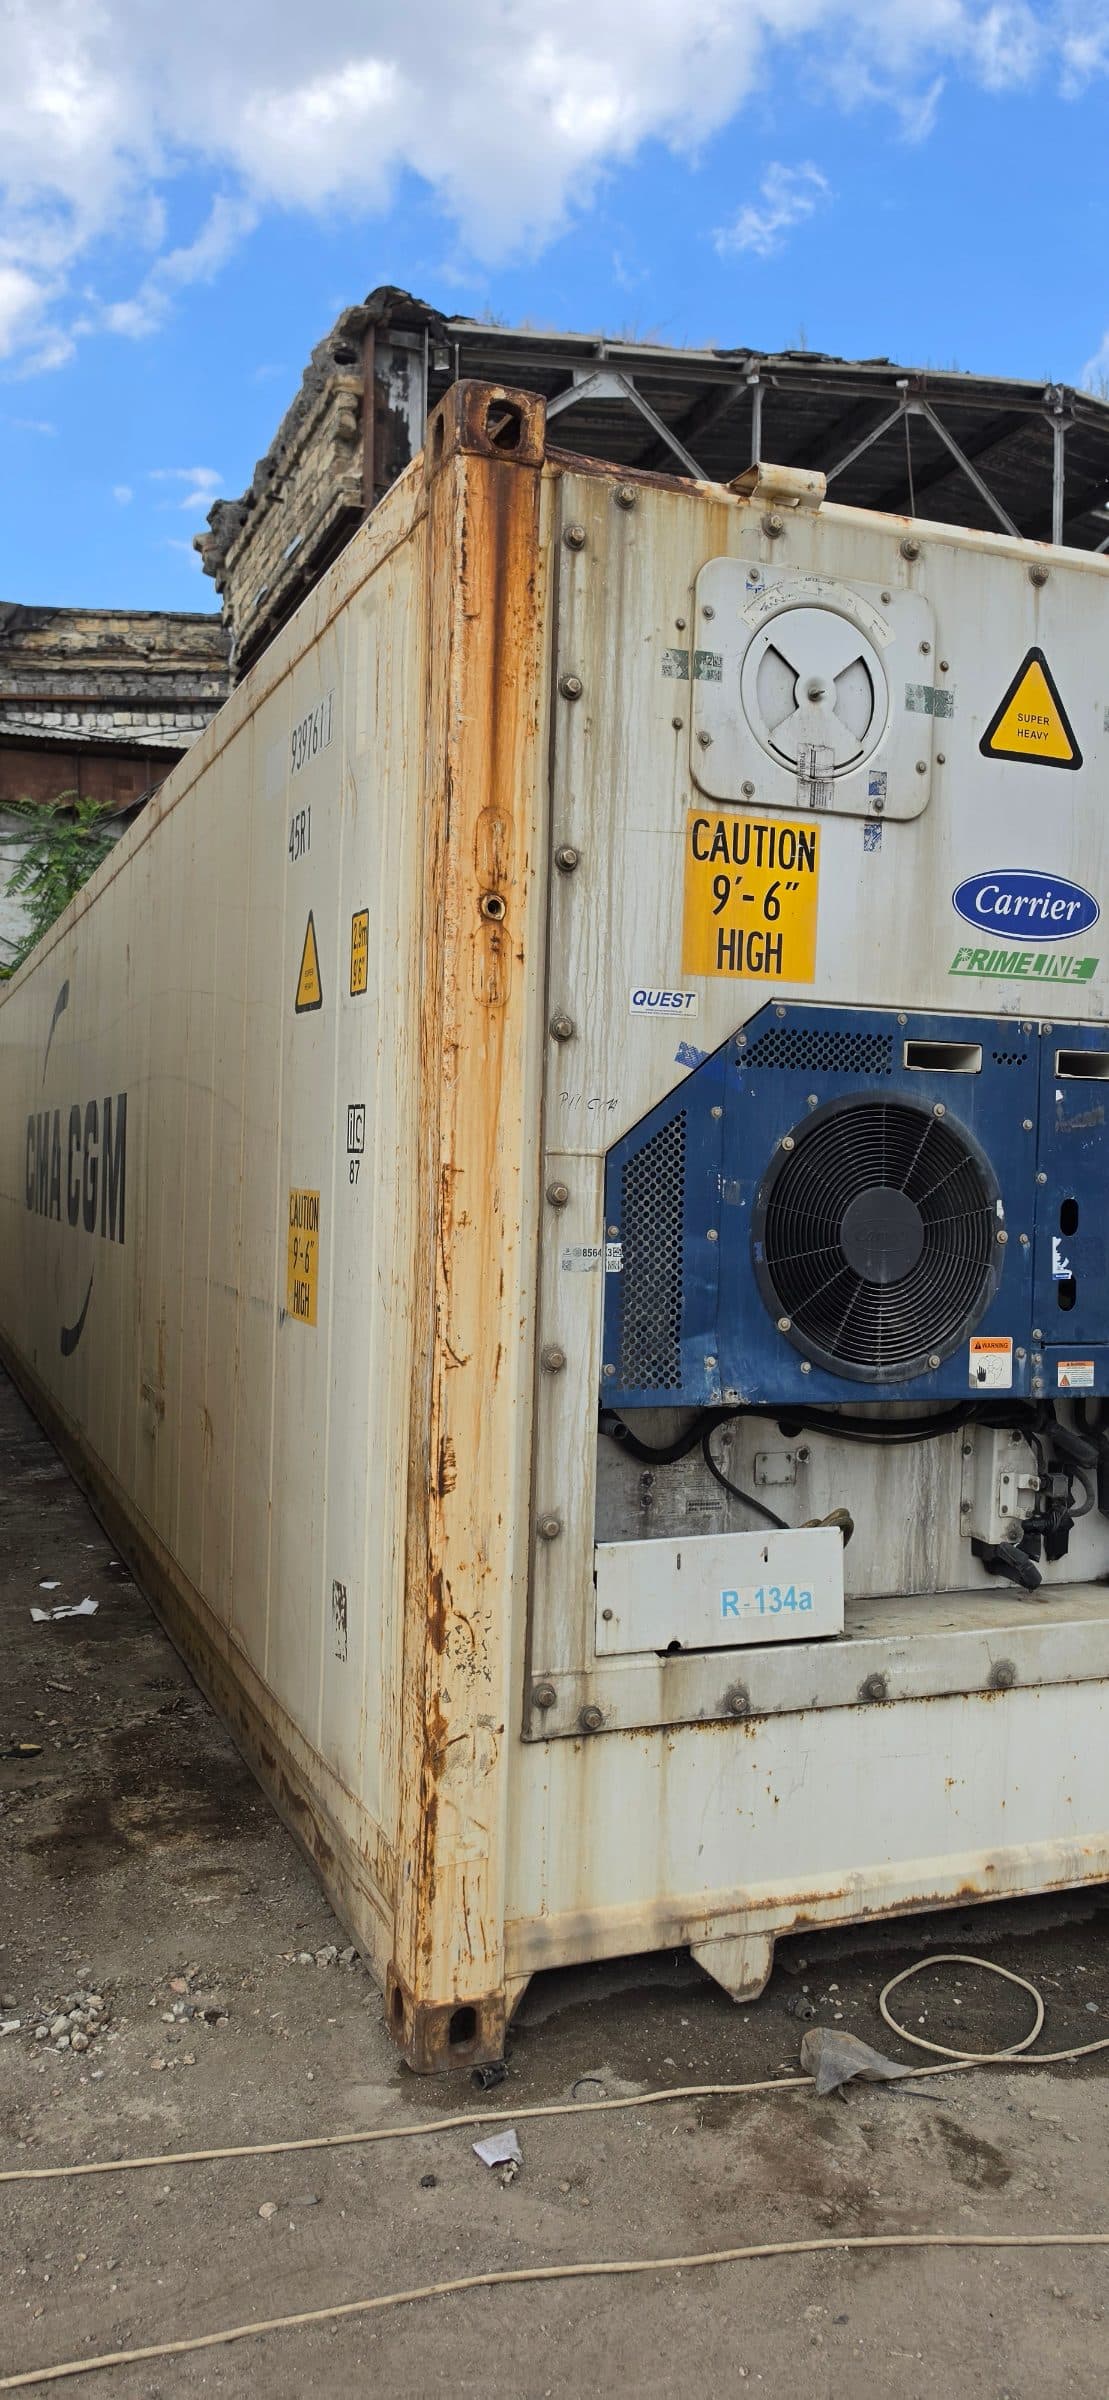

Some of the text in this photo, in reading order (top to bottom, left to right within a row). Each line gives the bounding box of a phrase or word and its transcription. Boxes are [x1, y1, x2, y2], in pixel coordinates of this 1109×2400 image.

[1016, 712, 1050, 727] SUPER
[1016, 727, 1050, 742] HEAVY
[288, 805, 311, 862] 45R1
[691, 818, 816, 873] CAUTION
[974, 885, 1081, 921] Carrier
[716, 927, 783, 975] HIGH
[632, 990, 696, 1009] QUEST
[25, 1092, 128, 1244] CMA CGM
[349, 1160, 361, 1185] 87
[289, 1194, 320, 1233] CAUTION
[293, 1282, 311, 1318] HIGH
[982, 1342, 1009, 1350] WARNING
